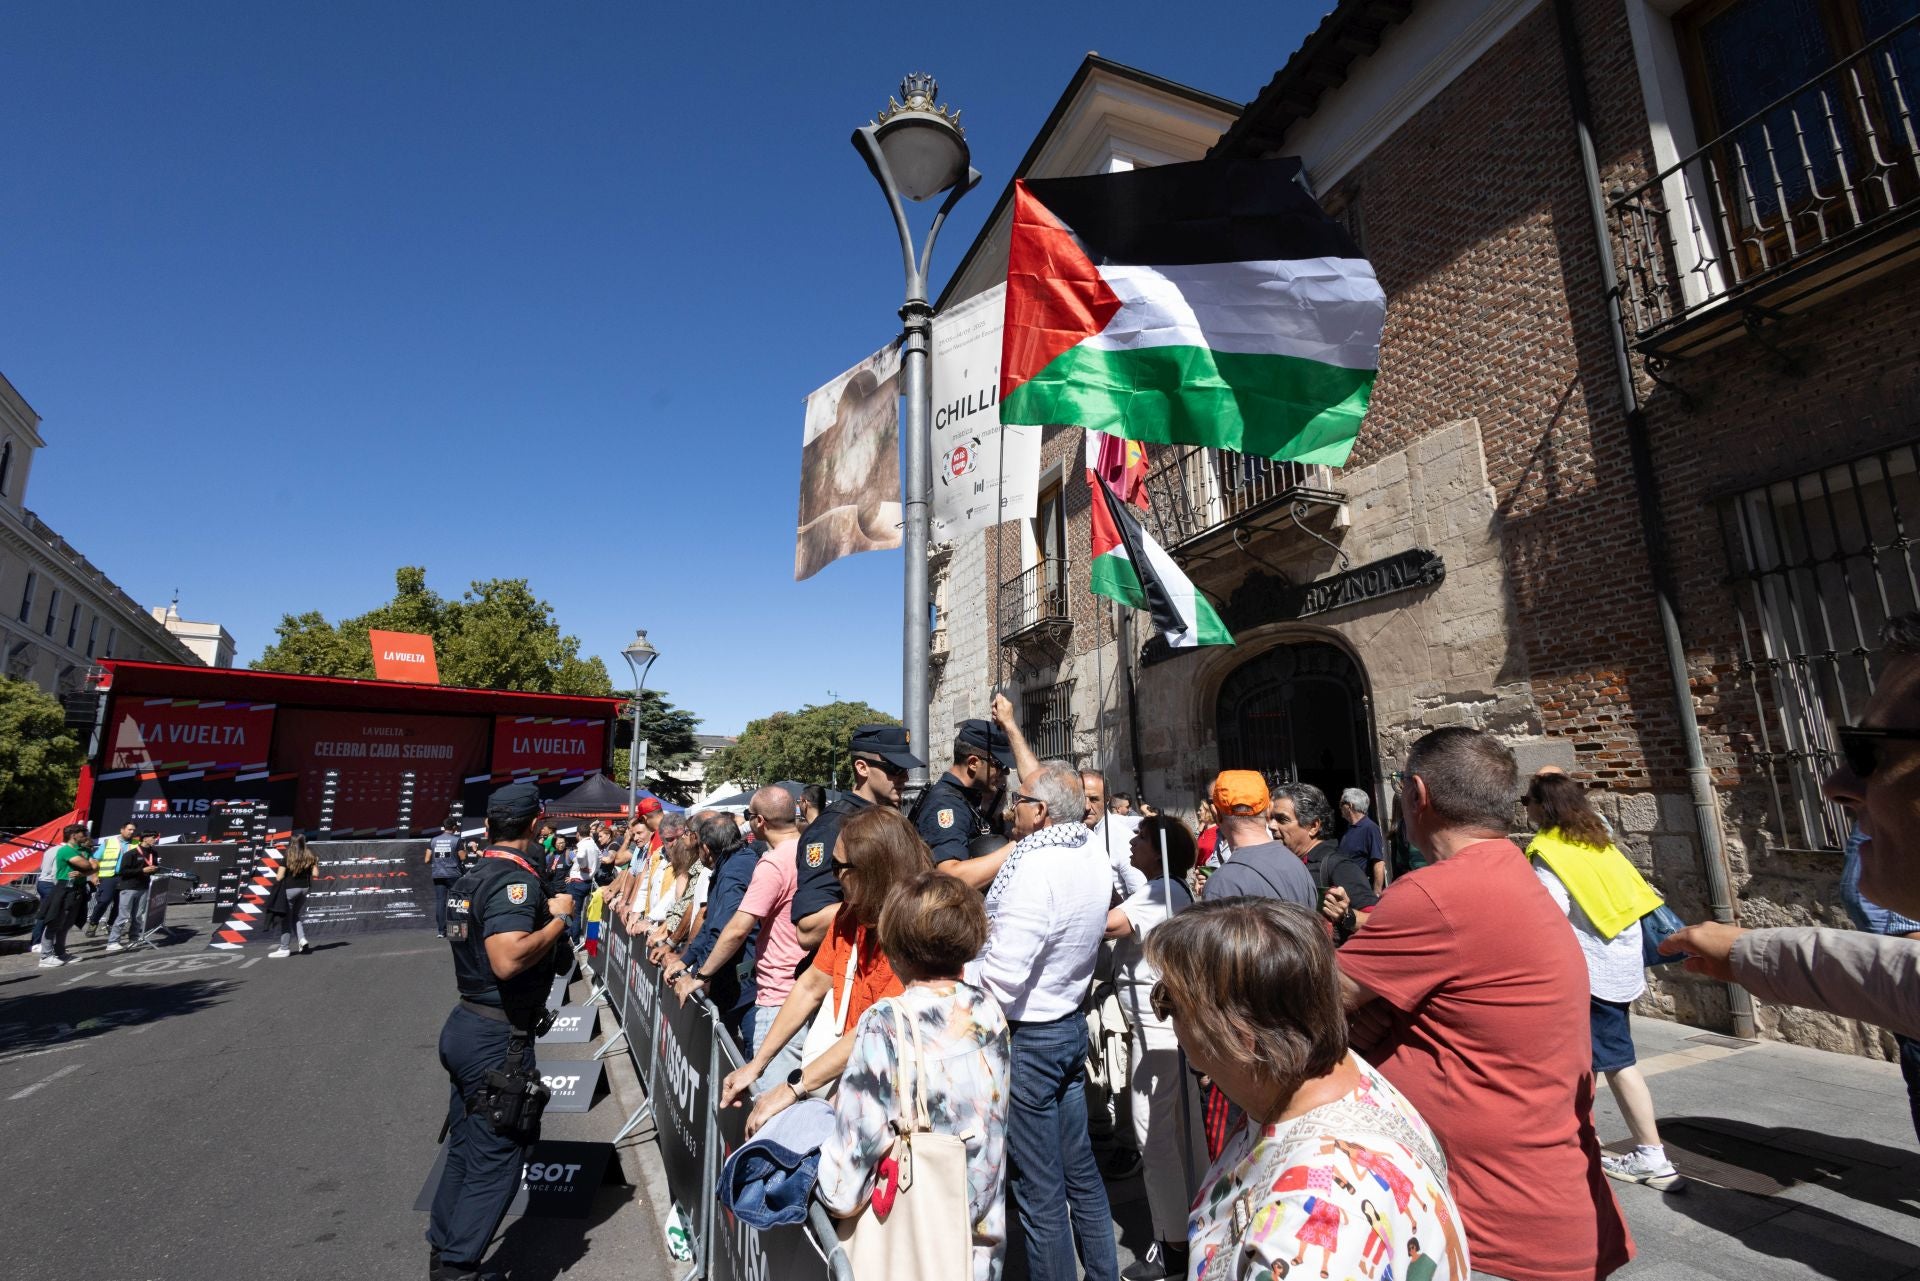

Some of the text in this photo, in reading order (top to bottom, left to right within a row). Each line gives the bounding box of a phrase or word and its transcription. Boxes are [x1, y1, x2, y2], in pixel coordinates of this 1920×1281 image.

[936, 384, 996, 430] CHILLI
[384, 651, 425, 663] LA VUELTA
[138, 723, 245, 745] LA VUELTA
[374, 728, 404, 737] VUELTA
[314, 741, 454, 759] CELEBRA CADA SEGUNDO
[513, 737, 586, 755] LA VUELTA
[340, 871, 408, 880] VUELTA
[635, 961, 654, 1018] TISSOT
[551, 1016, 581, 1027] SOT
[665, 1021, 700, 1123] TISSOT
[540, 1075, 581, 1089] SOT
[682, 1126, 697, 1158] 1853
[521, 1162, 581, 1183] SOT
[523, 1183, 550, 1192] SINCE
